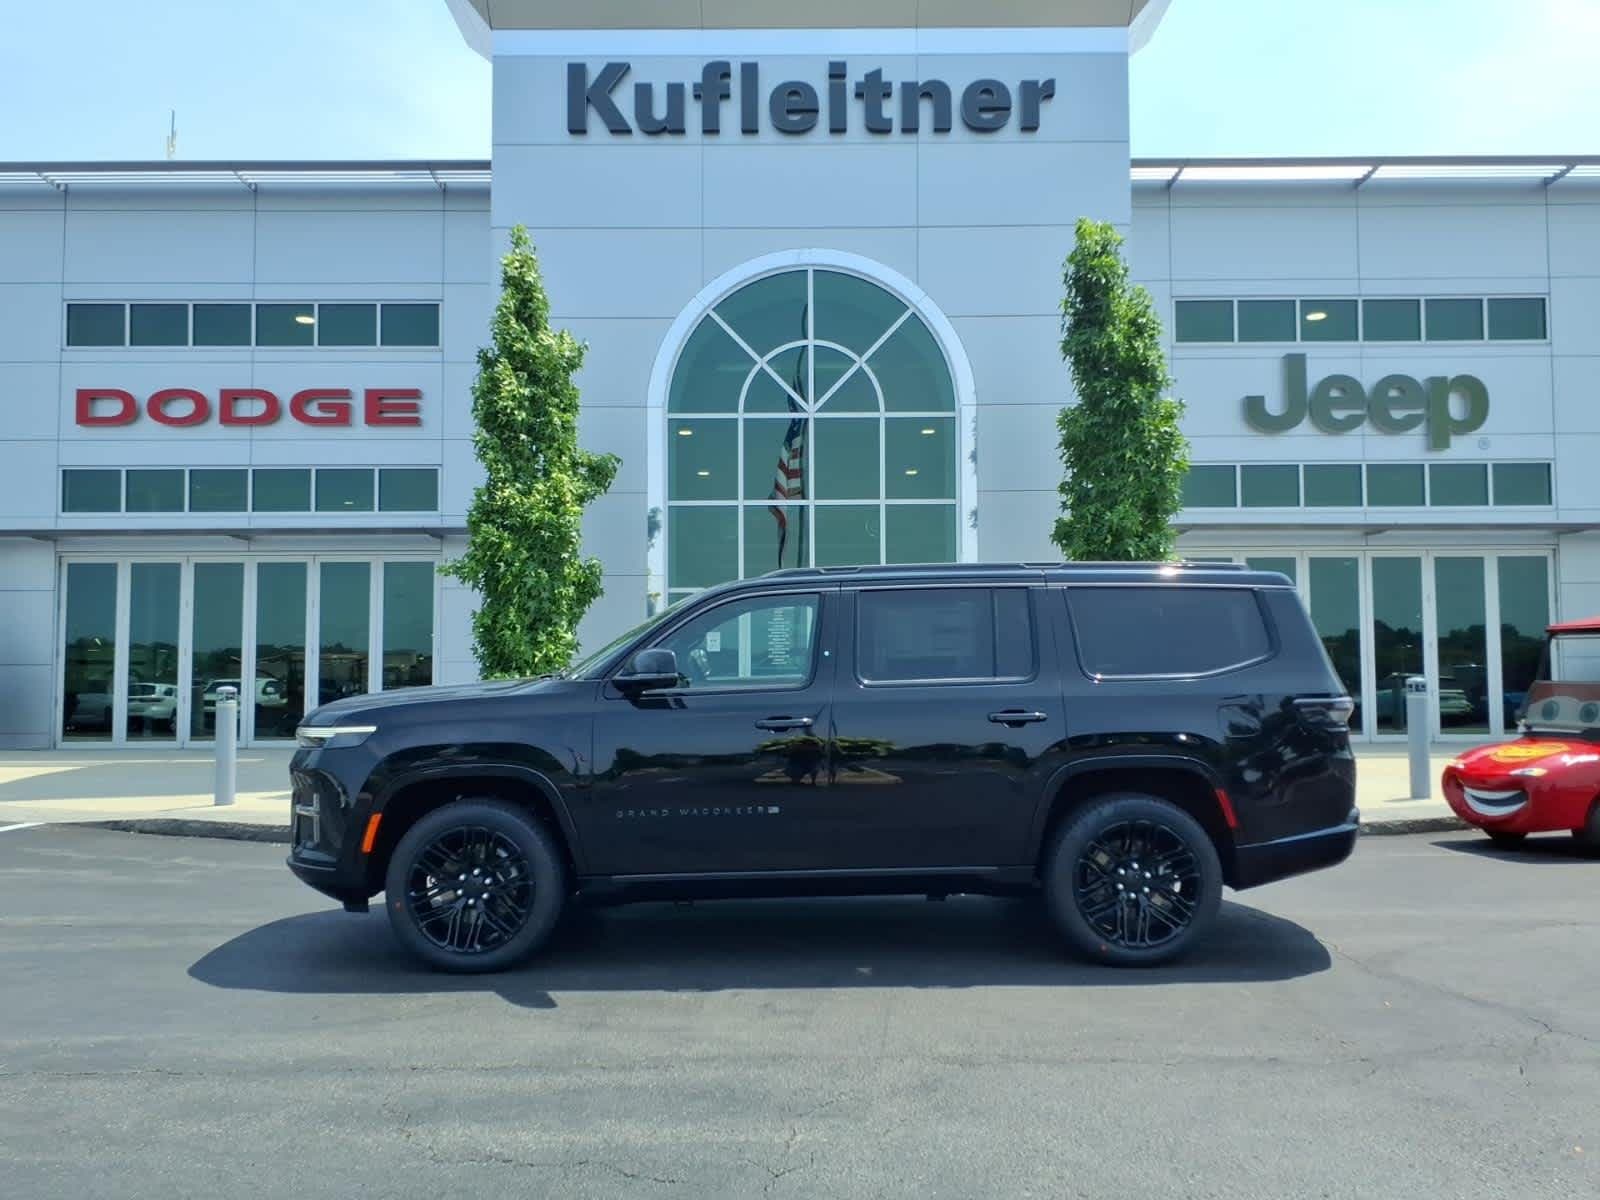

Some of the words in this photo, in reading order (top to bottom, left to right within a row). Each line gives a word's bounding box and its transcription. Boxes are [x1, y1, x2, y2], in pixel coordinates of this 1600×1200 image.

[567, 61, 1056, 134] Kufleitner
[76, 388, 422, 427] DODGE
[1241, 353, 1489, 451] Jeep
[616, 808, 670, 819] GRAND
